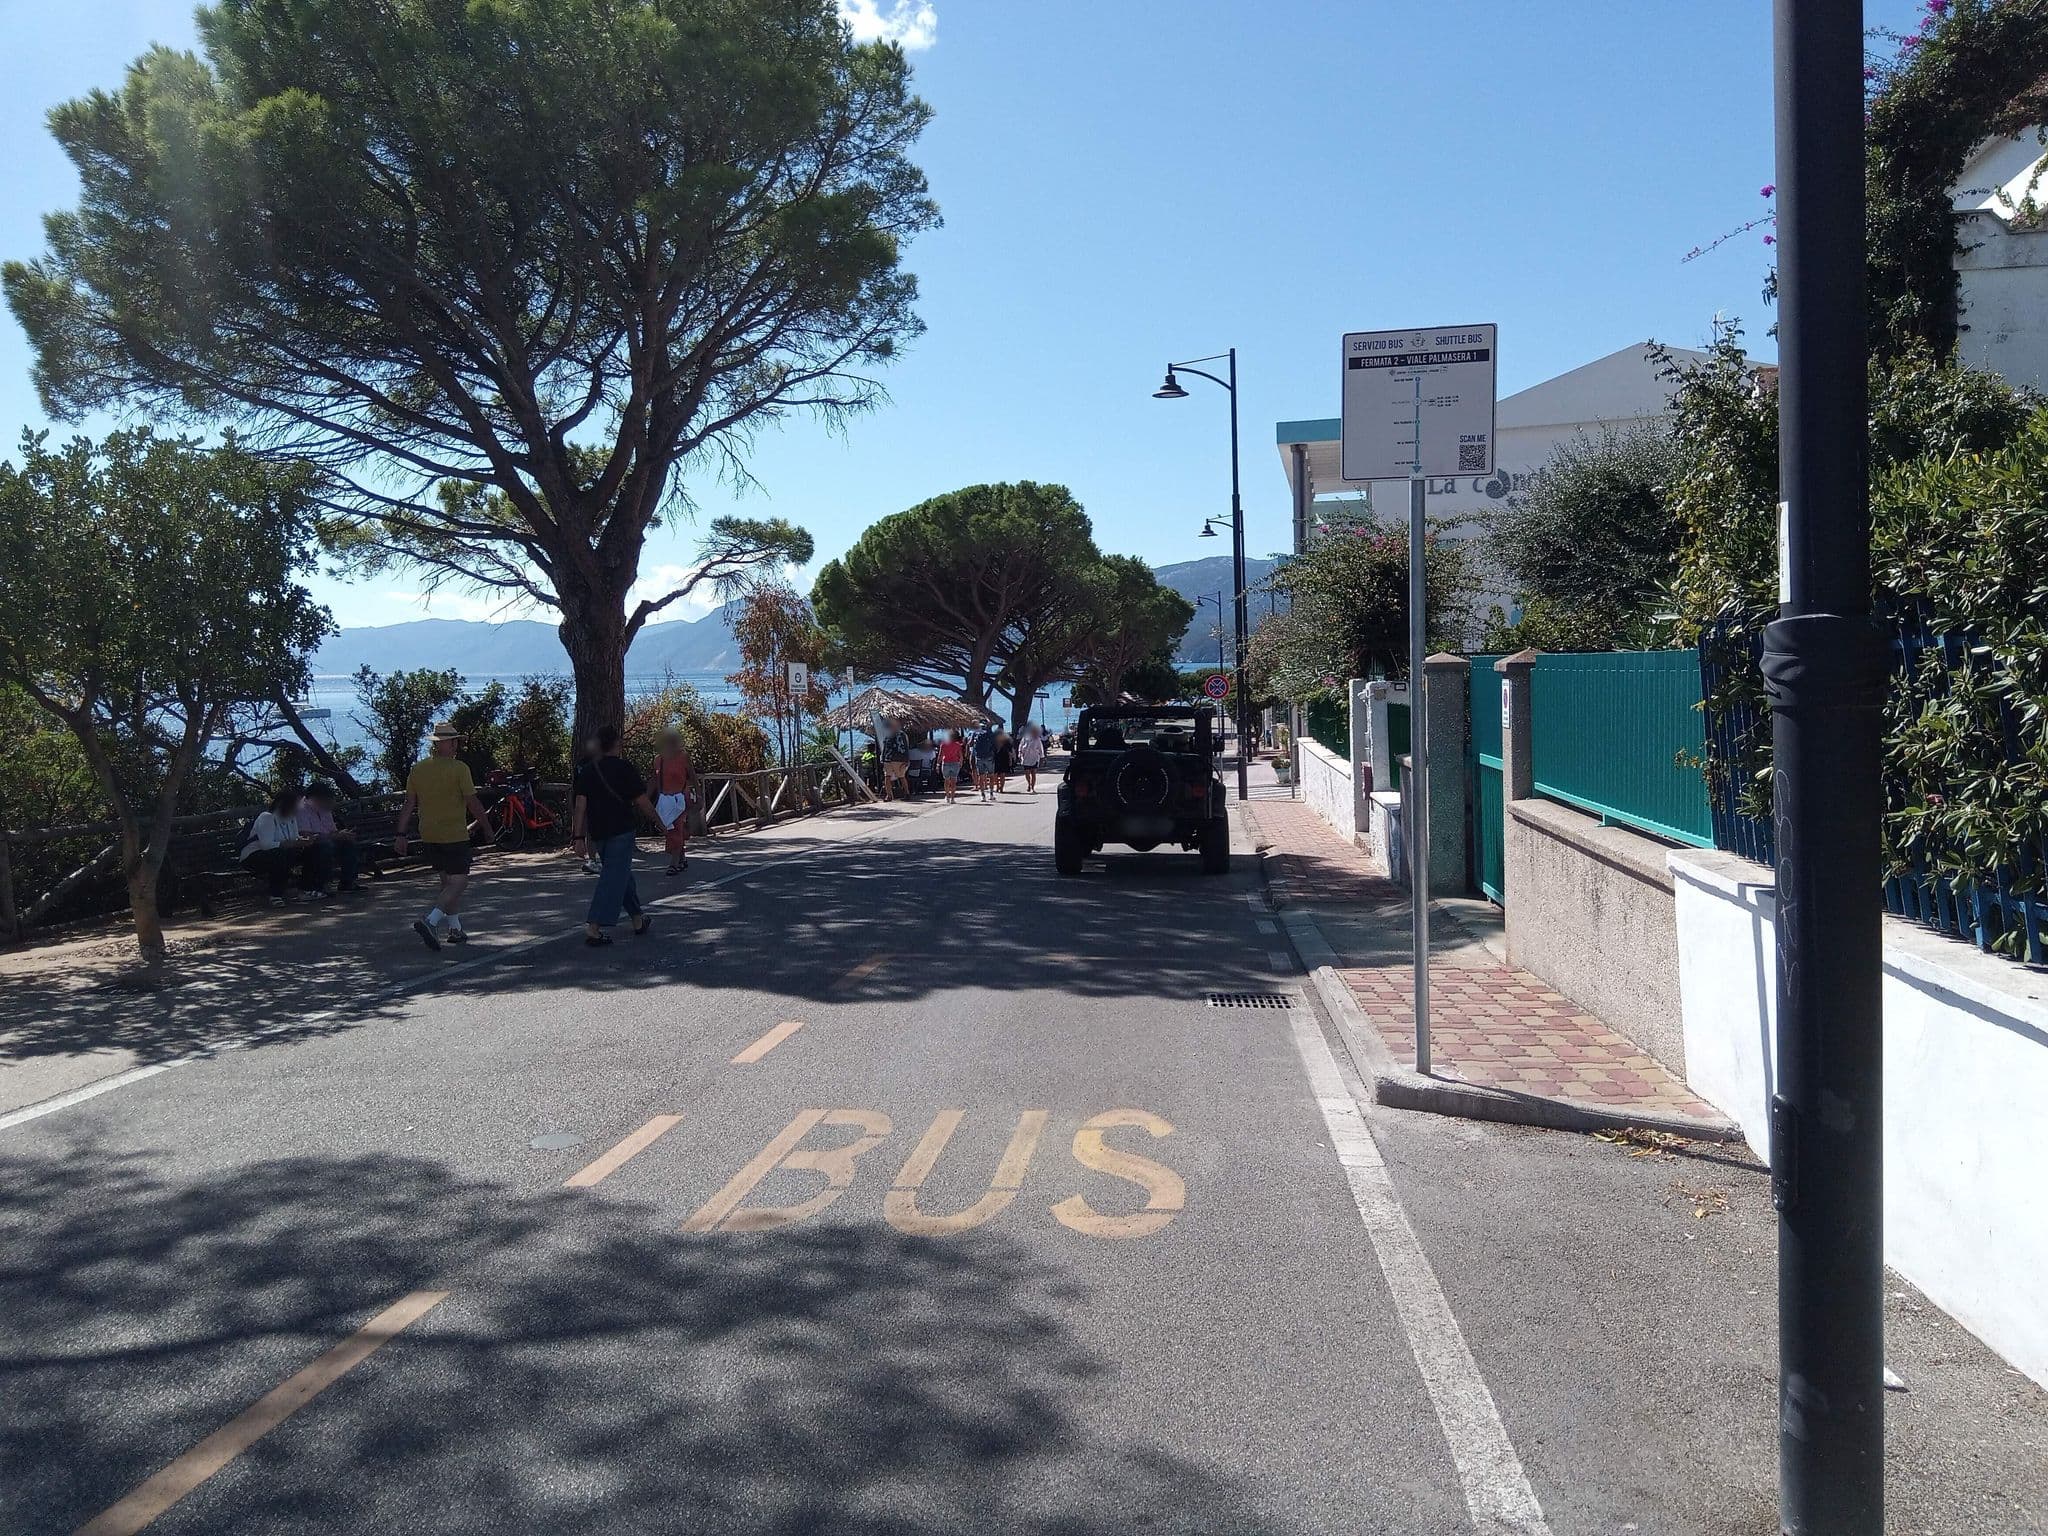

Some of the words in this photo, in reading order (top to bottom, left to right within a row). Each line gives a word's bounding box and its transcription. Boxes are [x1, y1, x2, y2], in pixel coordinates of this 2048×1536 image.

[1353, 340, 1387, 351] SERVIZIO
[1388, 339, 1404, 349] BUS
[1435, 335, 1466, 346] SHUTTLE
[1468, 333, 1483, 343] BUS
[1361, 357, 1392, 368] FERMATA
[1393, 358, 1399, 366] 2
[1406, 354, 1427, 365] VIALE
[1428, 352, 1471, 364] PALMASERA
[1473, 352, 1477, 360] 1
[1459, 434, 1475, 443] SCAN
[1477, 434, 1487, 442] ME
[681, 1108, 1187, 1239] BUS
